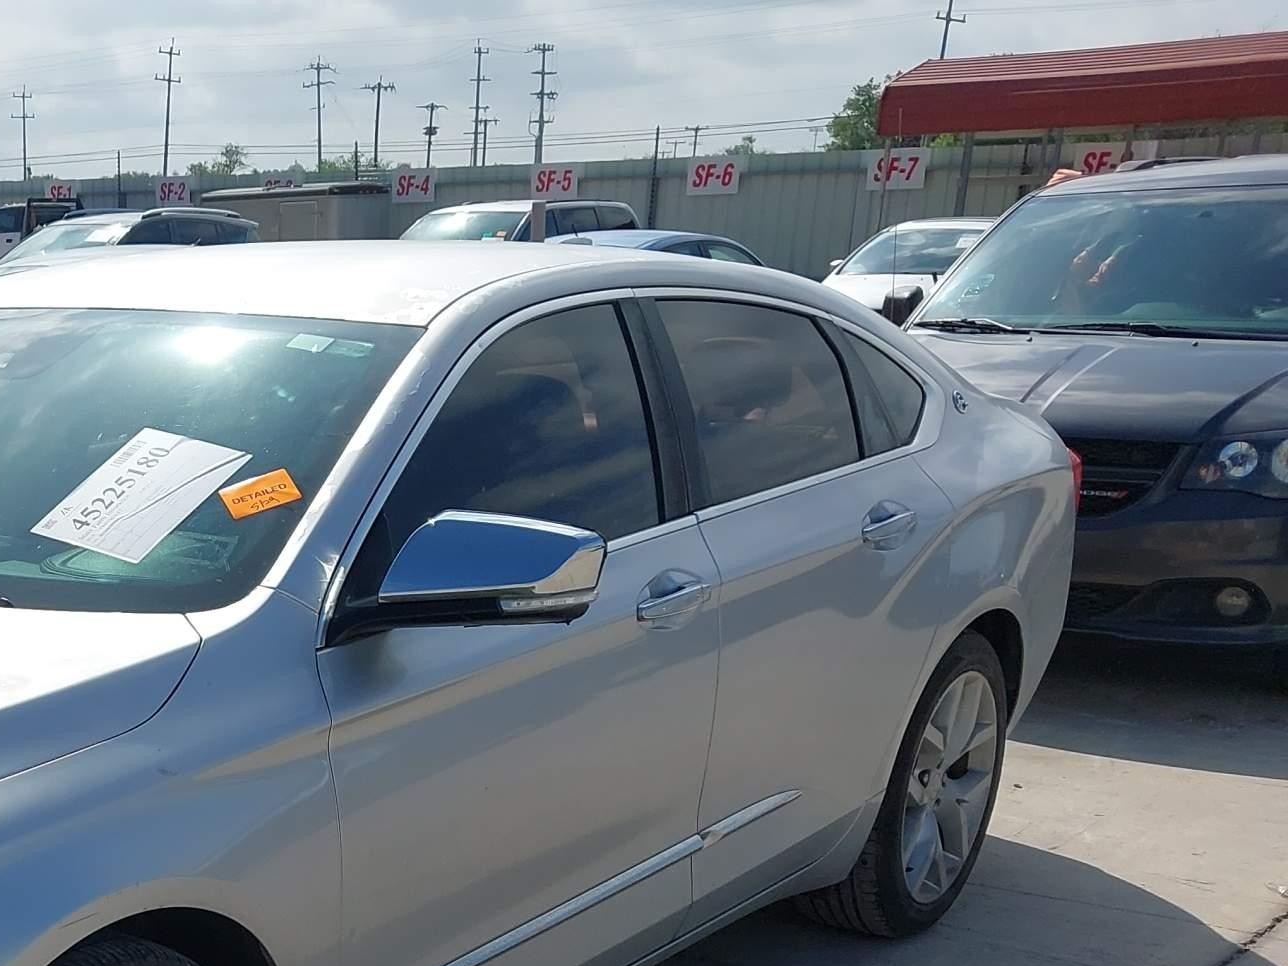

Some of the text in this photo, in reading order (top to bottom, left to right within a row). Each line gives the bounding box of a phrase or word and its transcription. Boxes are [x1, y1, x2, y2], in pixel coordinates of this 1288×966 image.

[692, 163, 735, 188] SF-6
[874, 157, 920, 182] SF-7
[50, 185, 73, 200] SF-1
[159, 182, 186, 201] SF-2
[396, 175, 431, 196] SF-4
[535, 170, 573, 193] SF-5
[72, 447, 170, 531] 45225180
[231, 483, 287, 505] DETAILED
